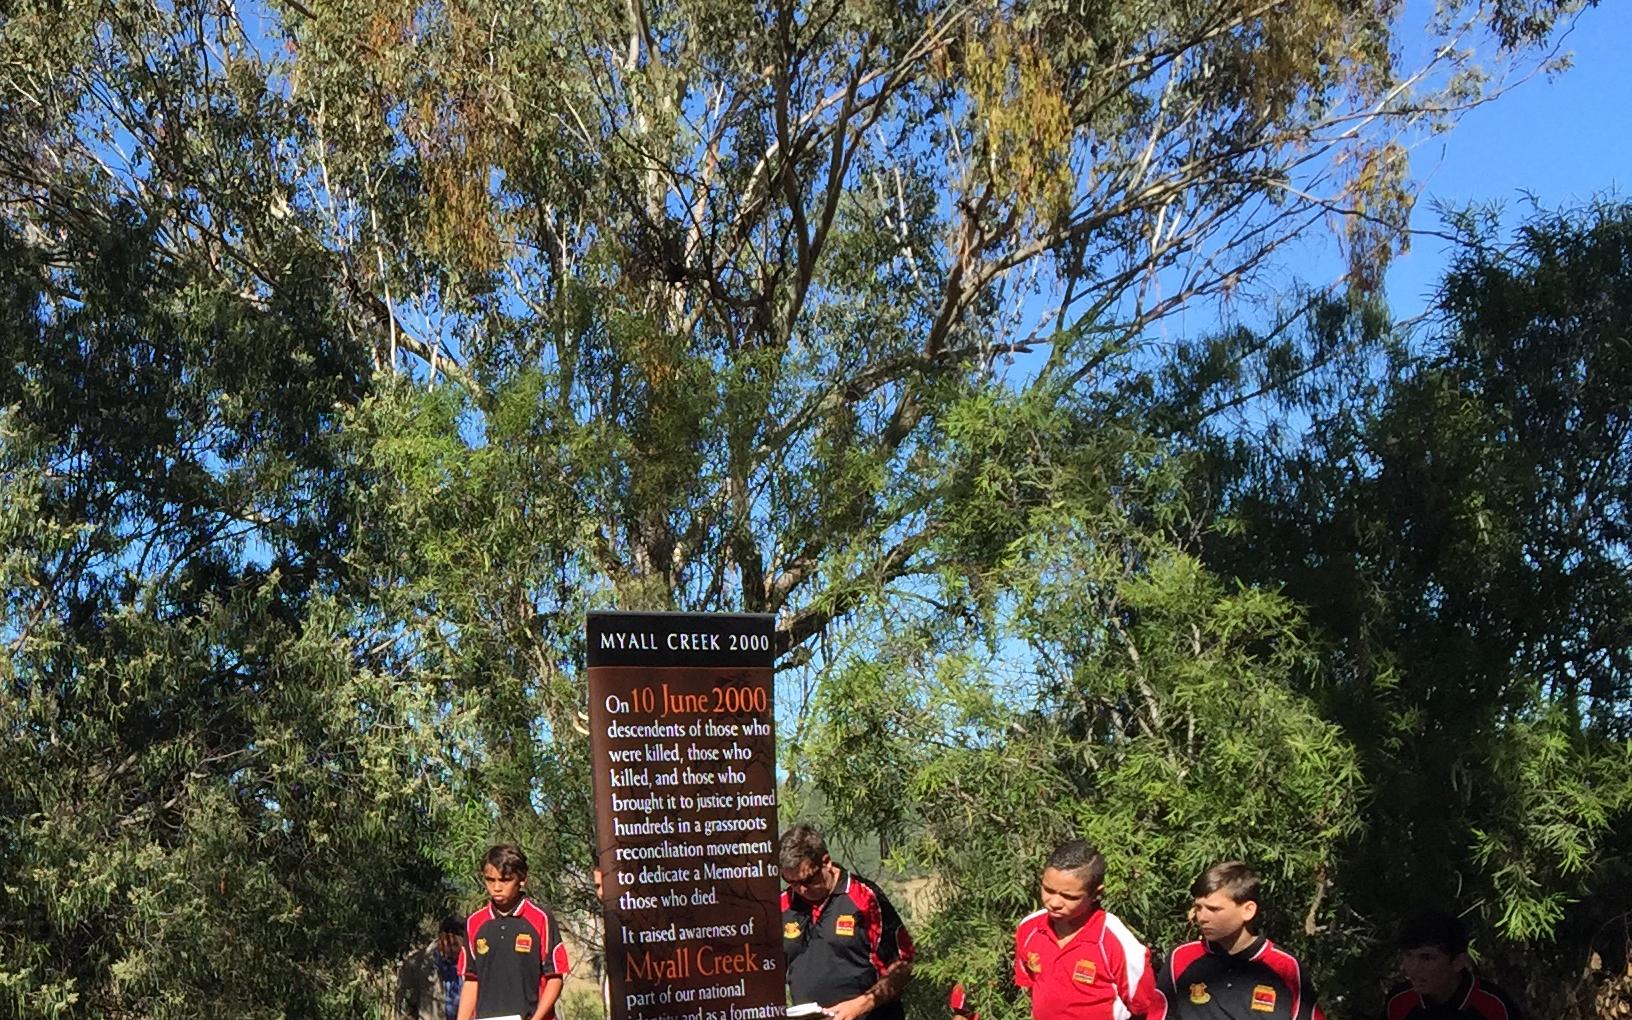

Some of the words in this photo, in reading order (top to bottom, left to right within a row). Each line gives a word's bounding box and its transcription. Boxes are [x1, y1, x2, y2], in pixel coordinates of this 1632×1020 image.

[601, 633, 658, 649] MYALL
[668, 634, 720, 650] CREEK
[729, 635, 768, 650] 2000
[606, 695, 629, 713] On
[631, 687, 655, 713] 10
[661, 684, 708, 718] June
[608, 720, 685, 738] descendents
[689, 719, 701, 736] of
[705, 720, 738, 736] those
[742, 718, 771, 736] who
[609, 751, 641, 762] were
[646, 744, 683, 764] killed,
[687, 743, 719, 760] those
[723, 743, 751, 759] who
[610, 769, 652, 788] killed,
[655, 769, 678, 785] and
[682, 768, 714, 785] those
[718, 767, 746, 783] who
[612, 793, 663, 813] brought
[667, 795, 676, 810] it
[681, 795, 693, 809] to
[696, 793, 733, 811] justice
[736, 789, 775, 810] joined
[614, 817, 674, 836] hundreds
[678, 820, 690, 833] in
[695, 822, 700, 832] a
[705, 817, 767, 836] grassroots
[617, 841, 703, 860] reconciliation
[707, 842, 772, 856] movement
[618, 871, 634, 885] to
[639, 866, 690, 883] dedicate
[694, 870, 700, 880] a
[704, 860, 762, 880] Memorial
[767, 864, 778, 876] to
[619, 892, 657, 910] those
[661, 890, 687, 907] who
[622, 926, 634, 944] It
[640, 923, 676, 942] raised
[679, 924, 737, 940] awareness
[740, 917, 754, 935] of
[625, 948, 690, 986] Myall
[697, 944, 758, 976] Creek
[763, 958, 776, 970] as
[627, 990, 655, 1010] part
[659, 985, 672, 1003] of
[675, 989, 695, 1001] our
[699, 979, 745, 999] national
[720, 1009, 726, 1020] a
